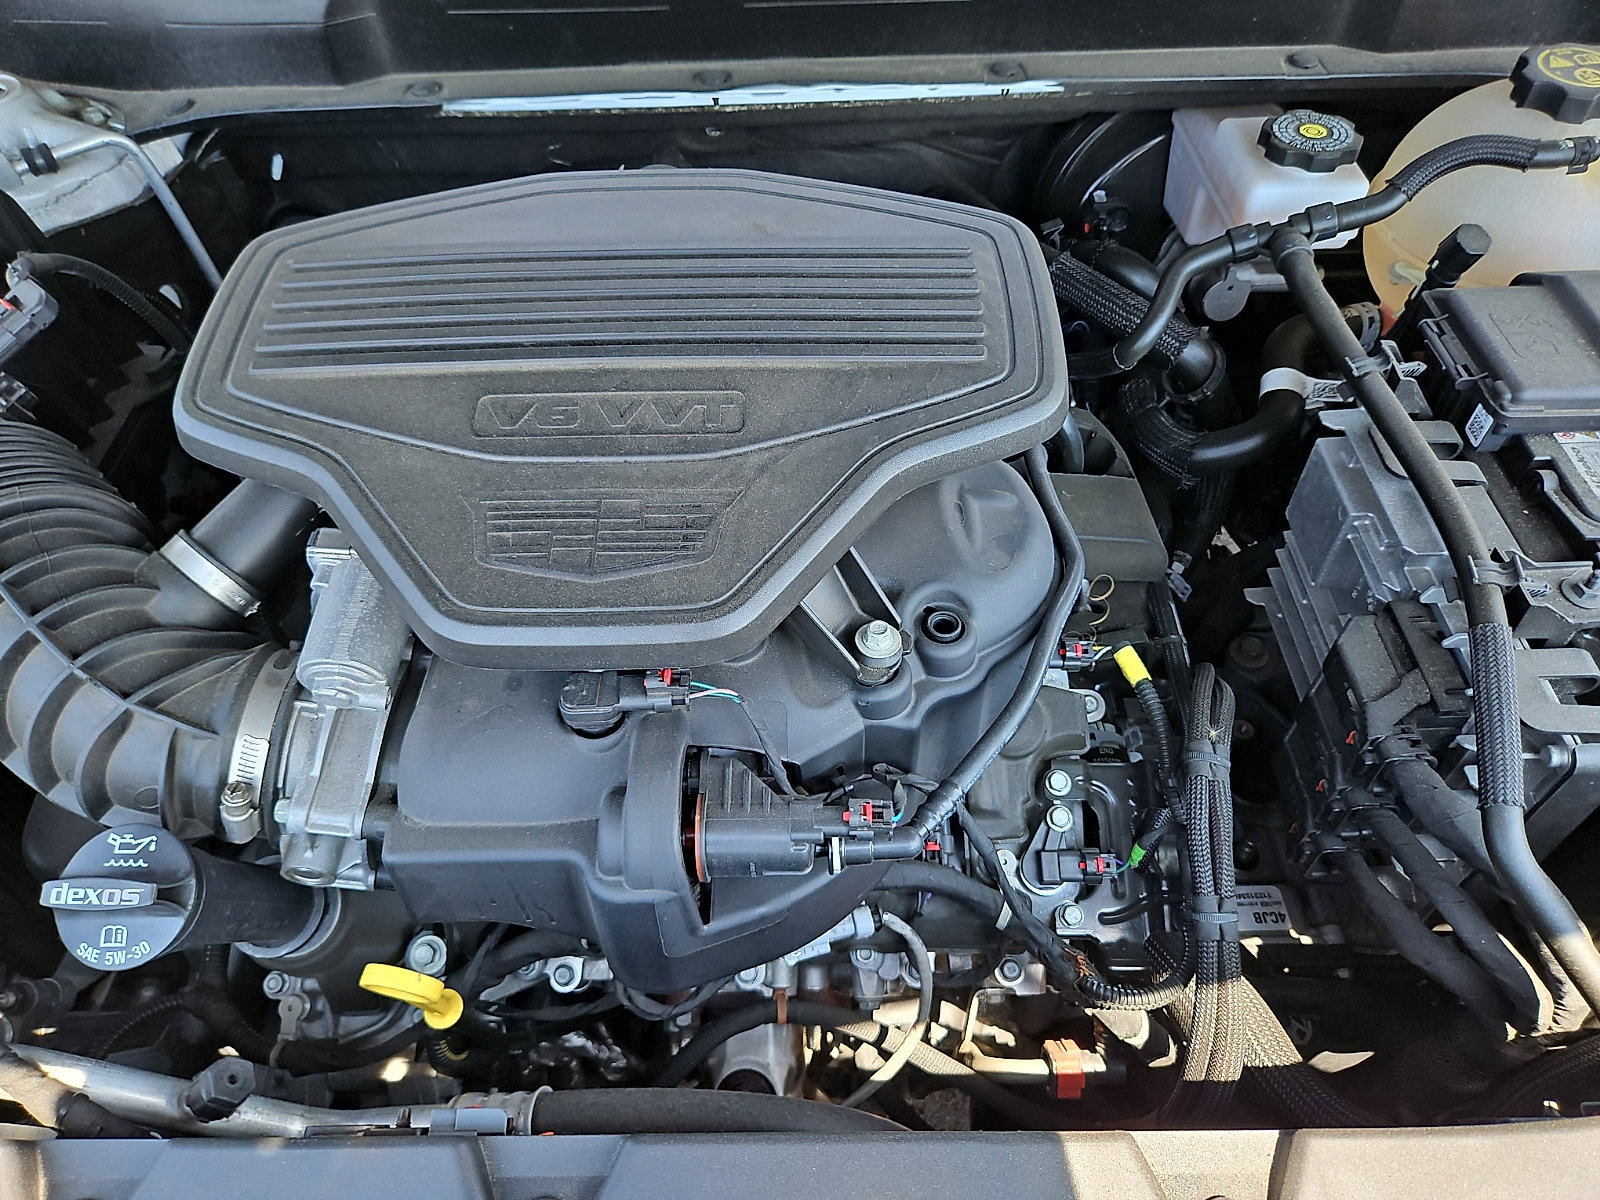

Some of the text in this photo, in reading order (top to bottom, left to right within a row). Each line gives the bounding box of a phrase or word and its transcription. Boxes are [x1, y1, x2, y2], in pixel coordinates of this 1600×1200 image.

[486, 400, 737, 430] V6 VVT
[50, 883, 141, 905] dexos
[1253, 911, 1286, 924] 4CJB
[77, 940, 151, 966] SAE 5W-30
